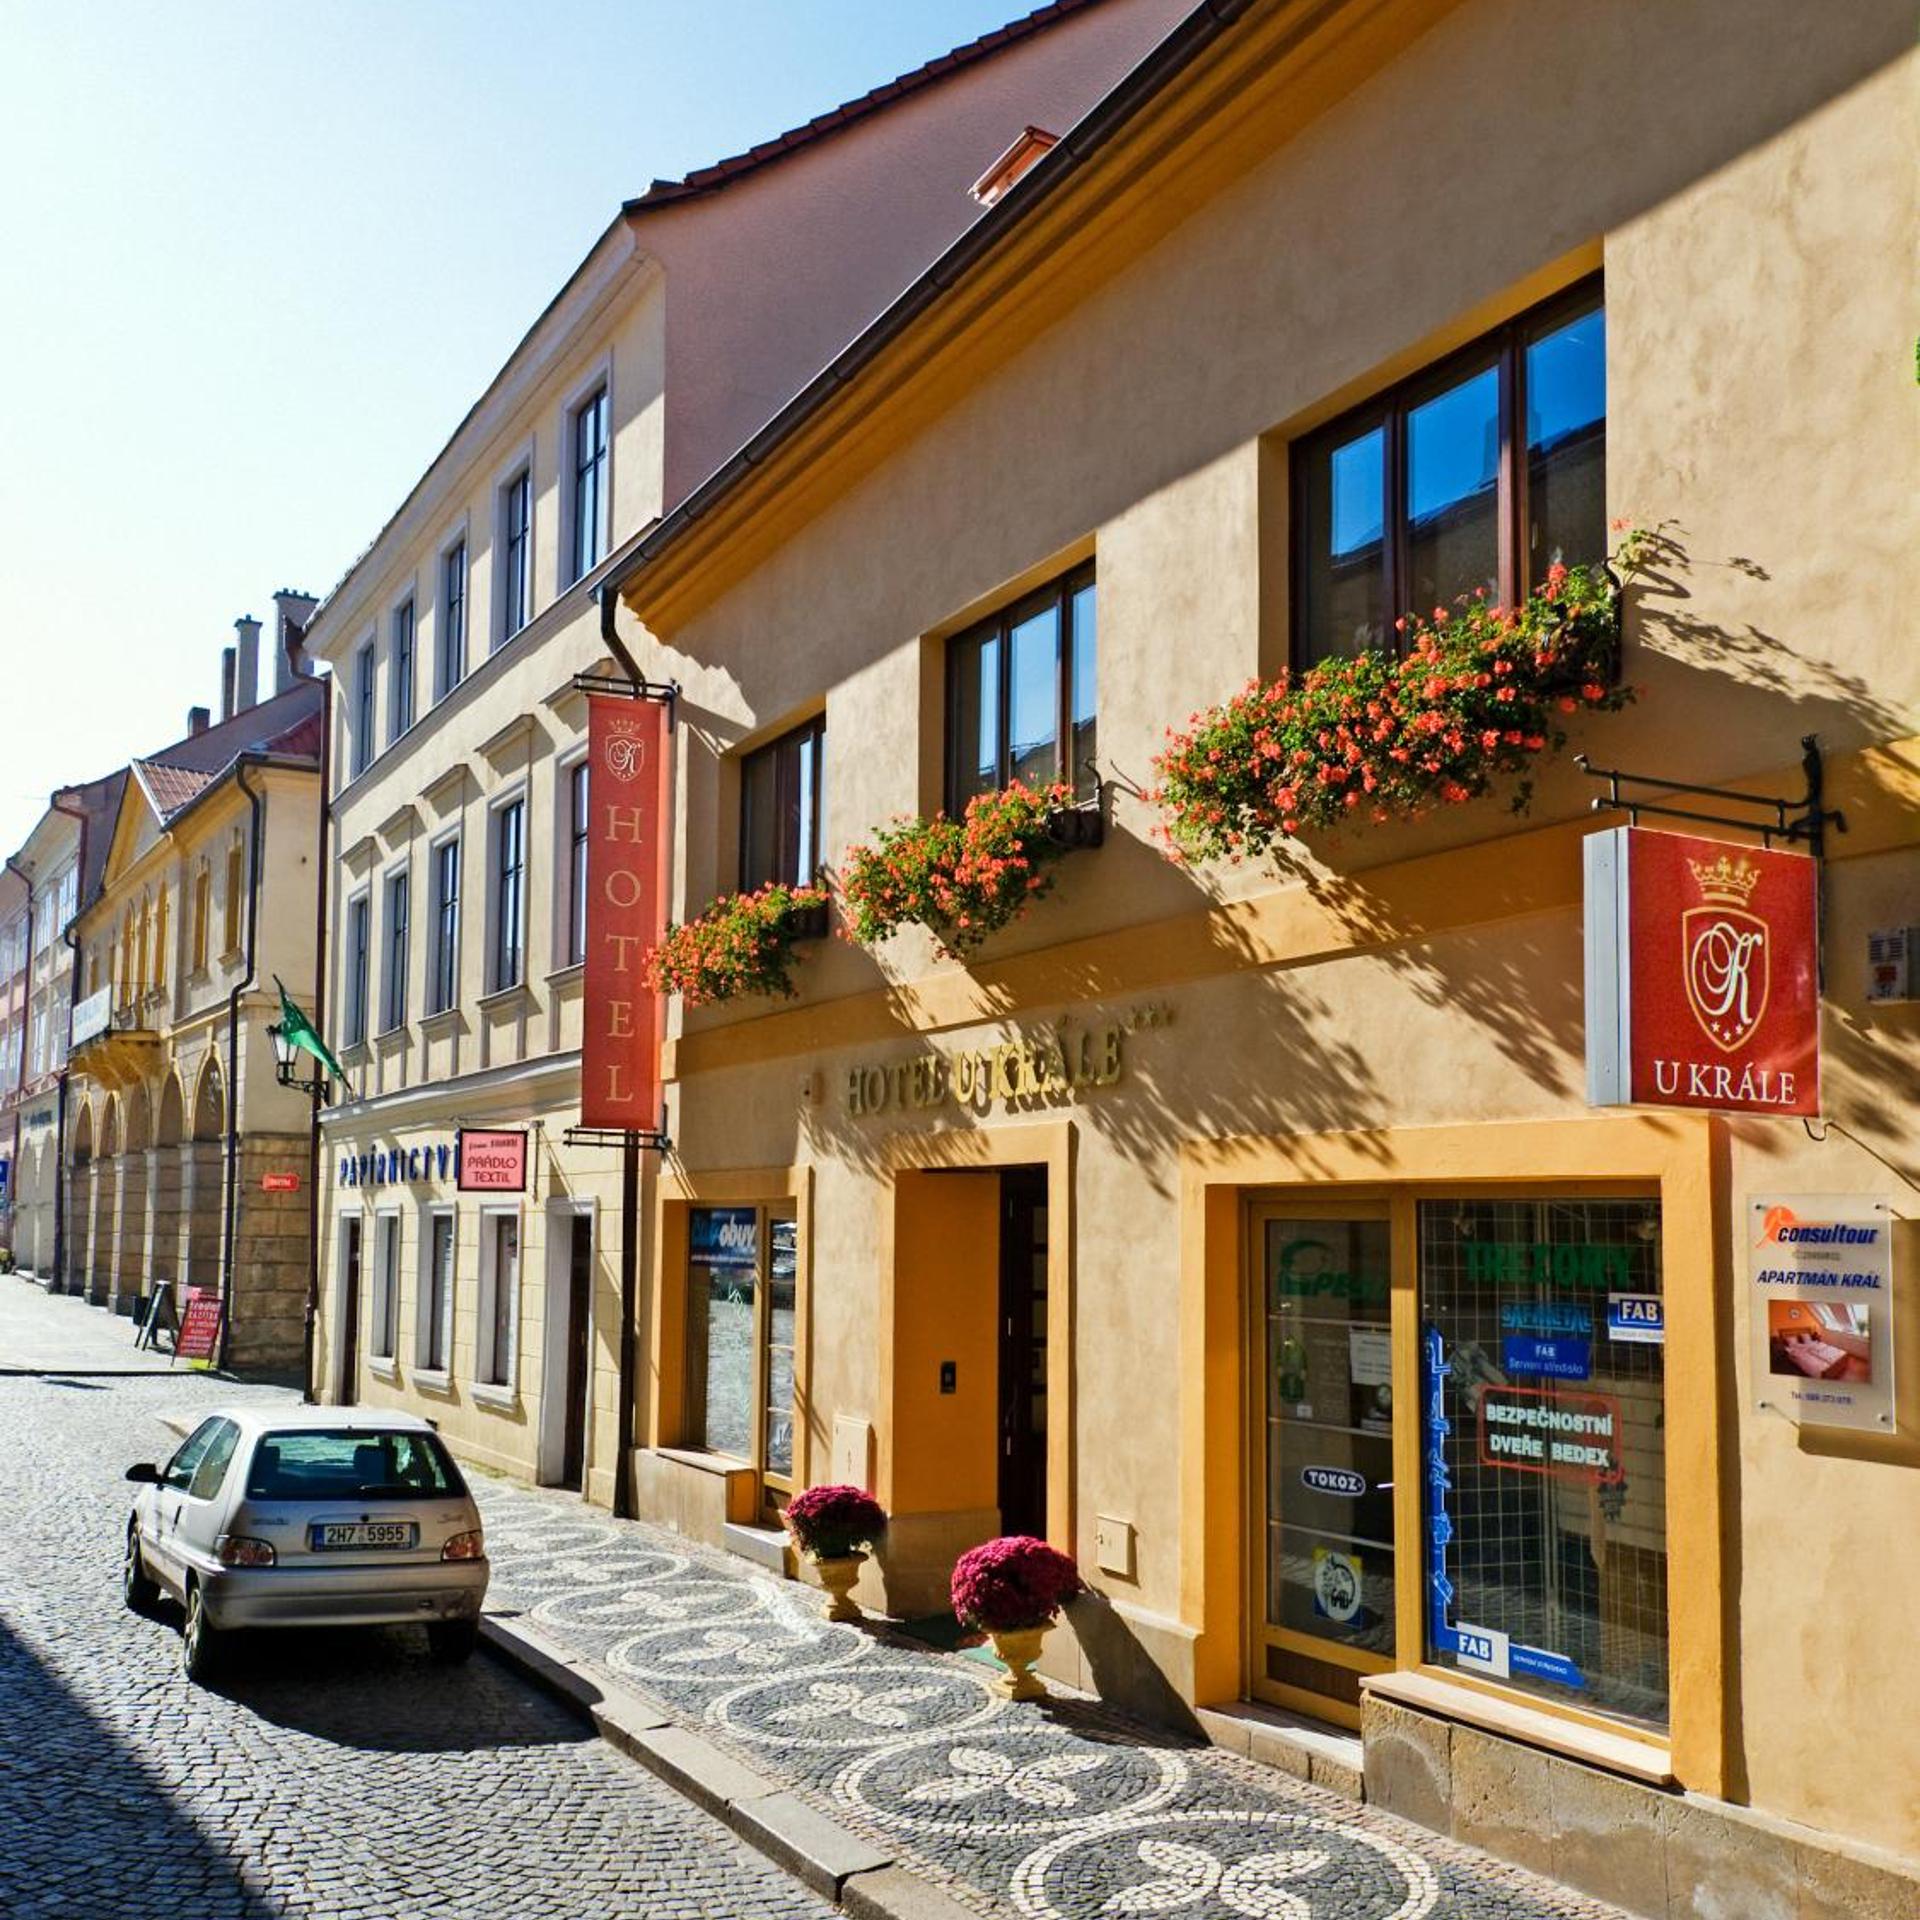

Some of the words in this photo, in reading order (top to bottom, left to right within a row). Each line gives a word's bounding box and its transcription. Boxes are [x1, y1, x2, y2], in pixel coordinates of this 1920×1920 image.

[604, 804, 643, 1102] HOTEL
[848, 1053, 946, 1114] HOTEL
[955, 1049, 981, 1103] U
[988, 1013, 1122, 1100] KRÁLE
[1654, 1059, 1681, 1095] U
[1687, 1062, 1797, 1105] KRÁLE
[467, 1155, 518, 1169] PRÁDLO
[471, 1171, 511, 1183] TEXTIL
[1777, 1223, 1879, 1245] consultour
[1622, 1301, 1658, 1322] FAB
[1486, 1404, 1613, 1436] BEZPEČNOSTNÍ
[1490, 1433, 1543, 1457] DVEŘE
[1551, 1442, 1610, 1467] BEDEX
[1308, 1471, 1358, 1491] TOKOZ
[327, 1526, 356, 1543] 2H7
[367, 1525, 405, 1542] 5955
[1459, 1633, 1490, 1659] FAB
